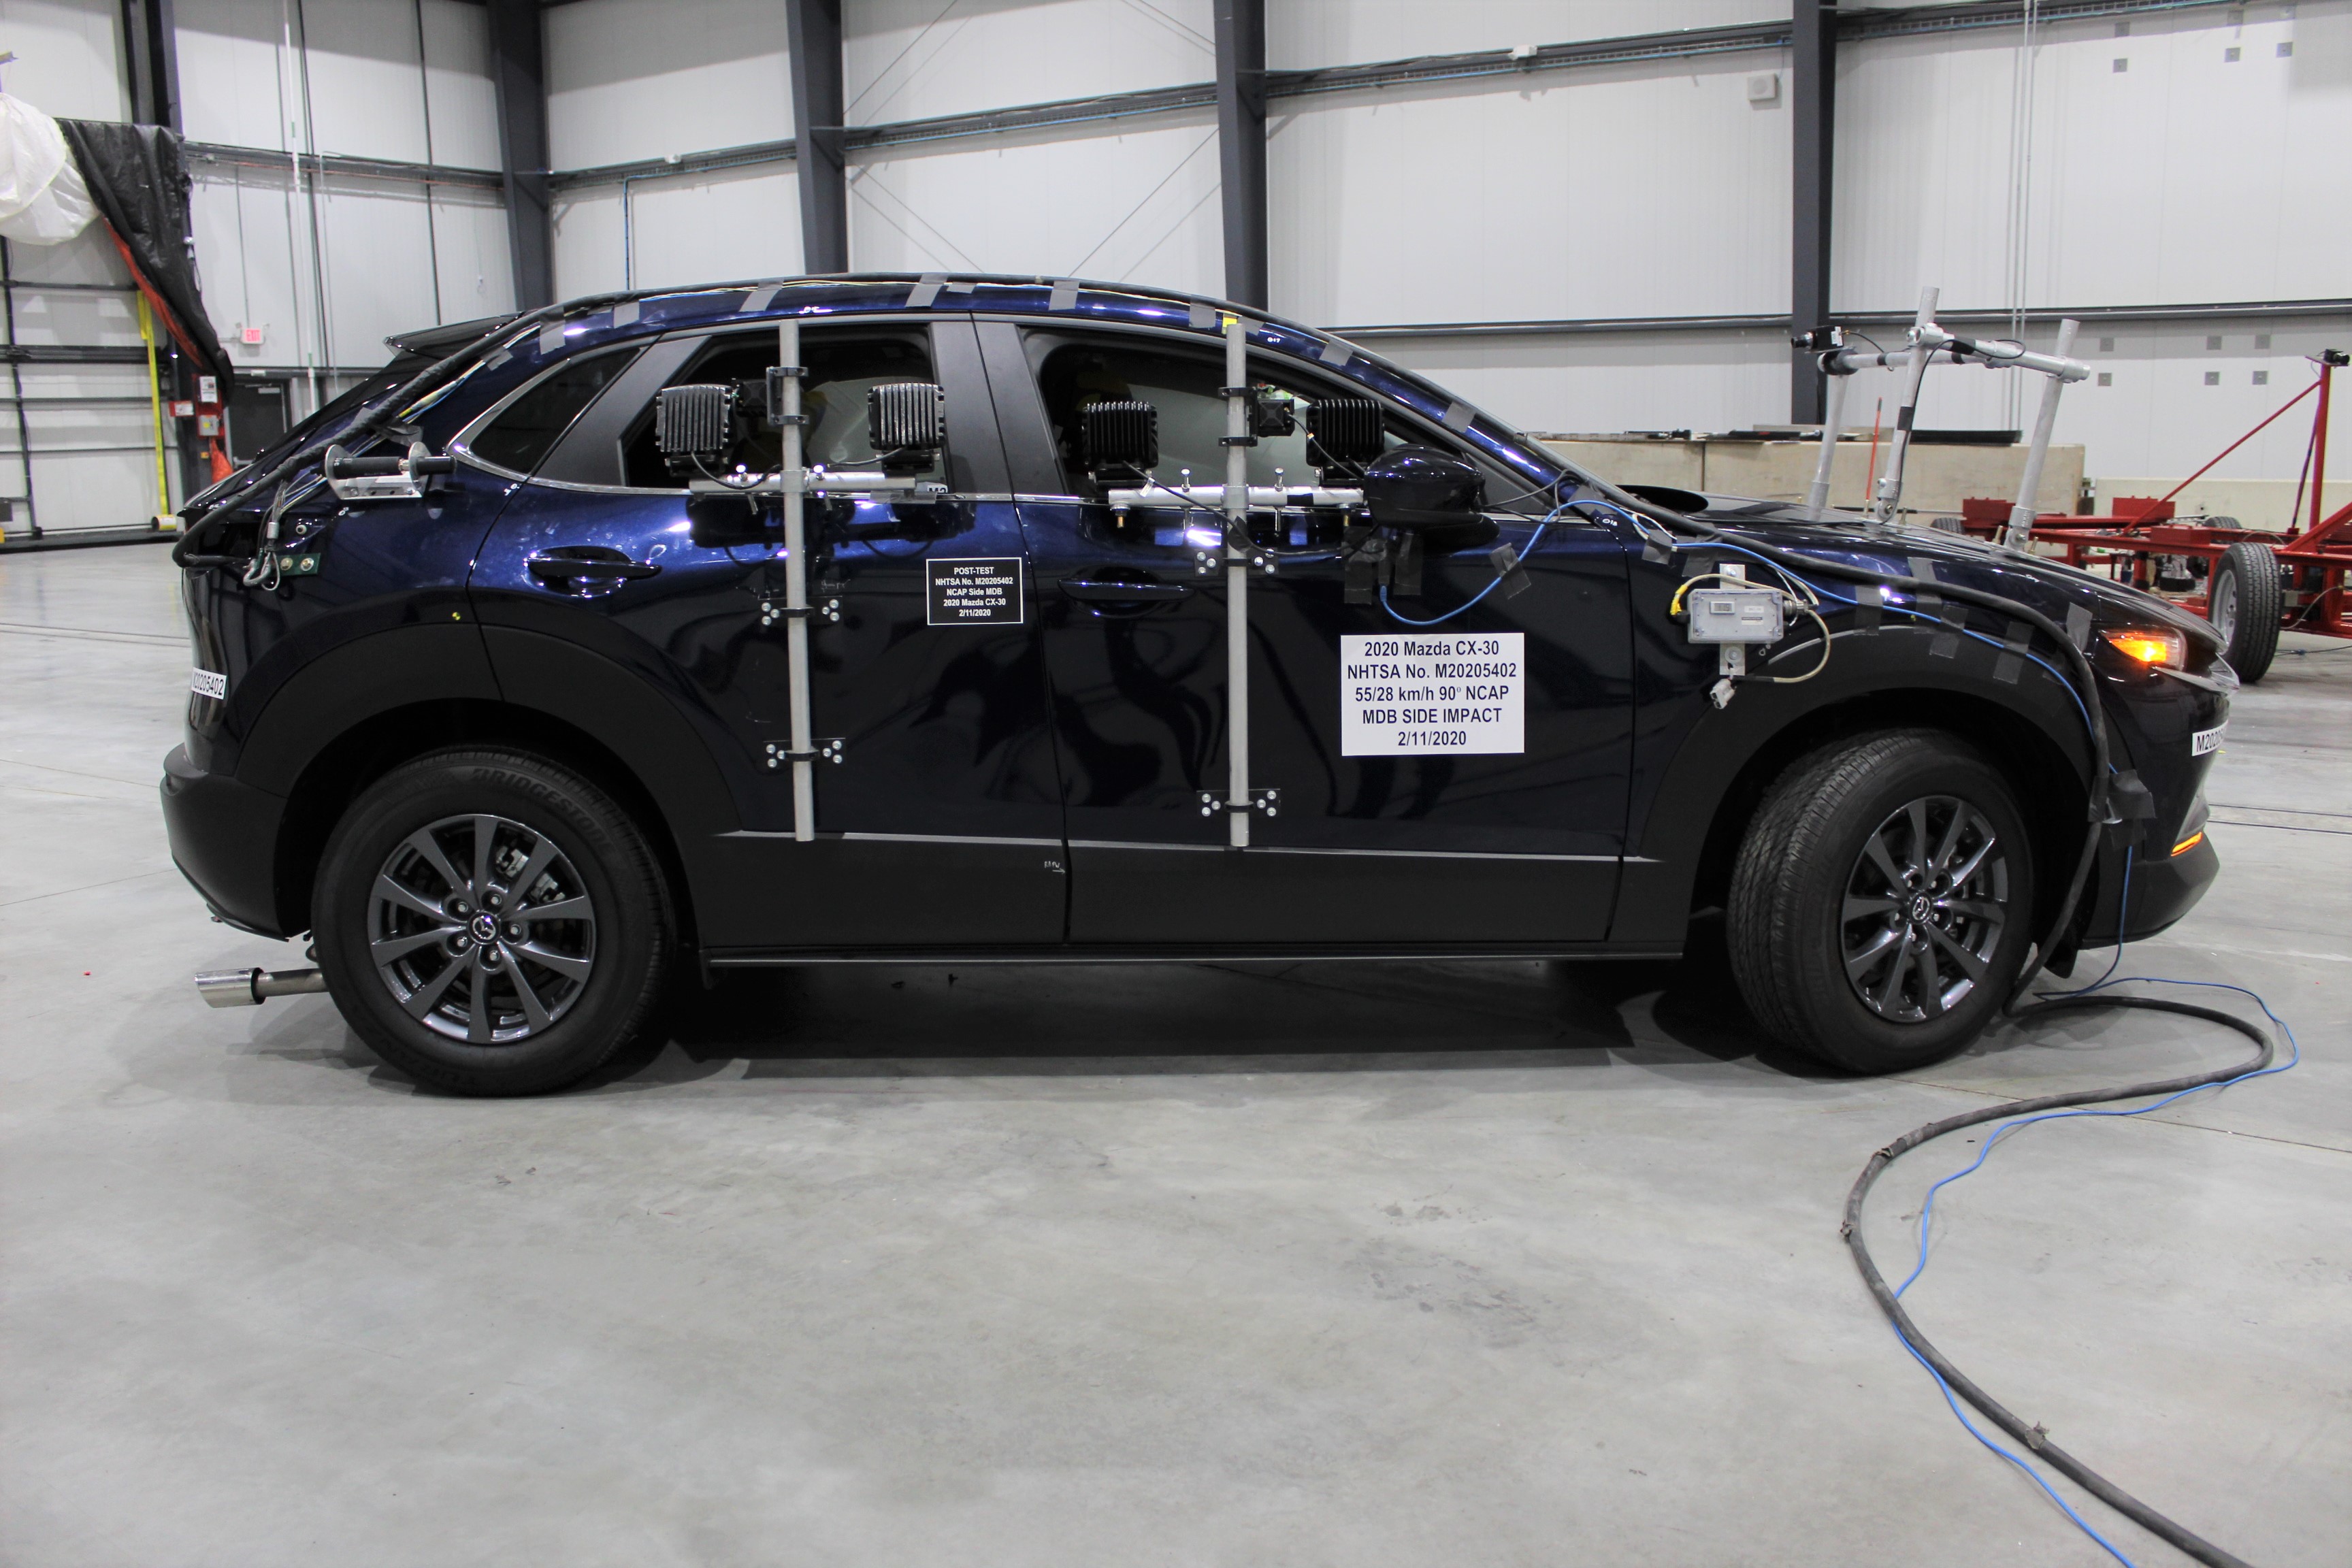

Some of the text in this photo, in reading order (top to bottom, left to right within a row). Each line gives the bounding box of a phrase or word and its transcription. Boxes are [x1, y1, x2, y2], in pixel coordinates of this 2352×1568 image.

[246, 329, 261, 342] EXIT
[953, 567, 994, 575] POST-TEST
[961, 598, 984, 606] Mazda
[1364, 640, 1499, 657] 2020 Mazda CX-30
[1348, 663, 1516, 679] NHTSA No. M20205402
[1355, 687, 1394, 702] 55/28
[1399, 686, 1434, 701] km/h
[1466, 685, 1509, 700] NCAP
[1362, 708, 1502, 724] MDB SIDE IMPACT
[1398, 731, 1467, 746] 2/11/2020
